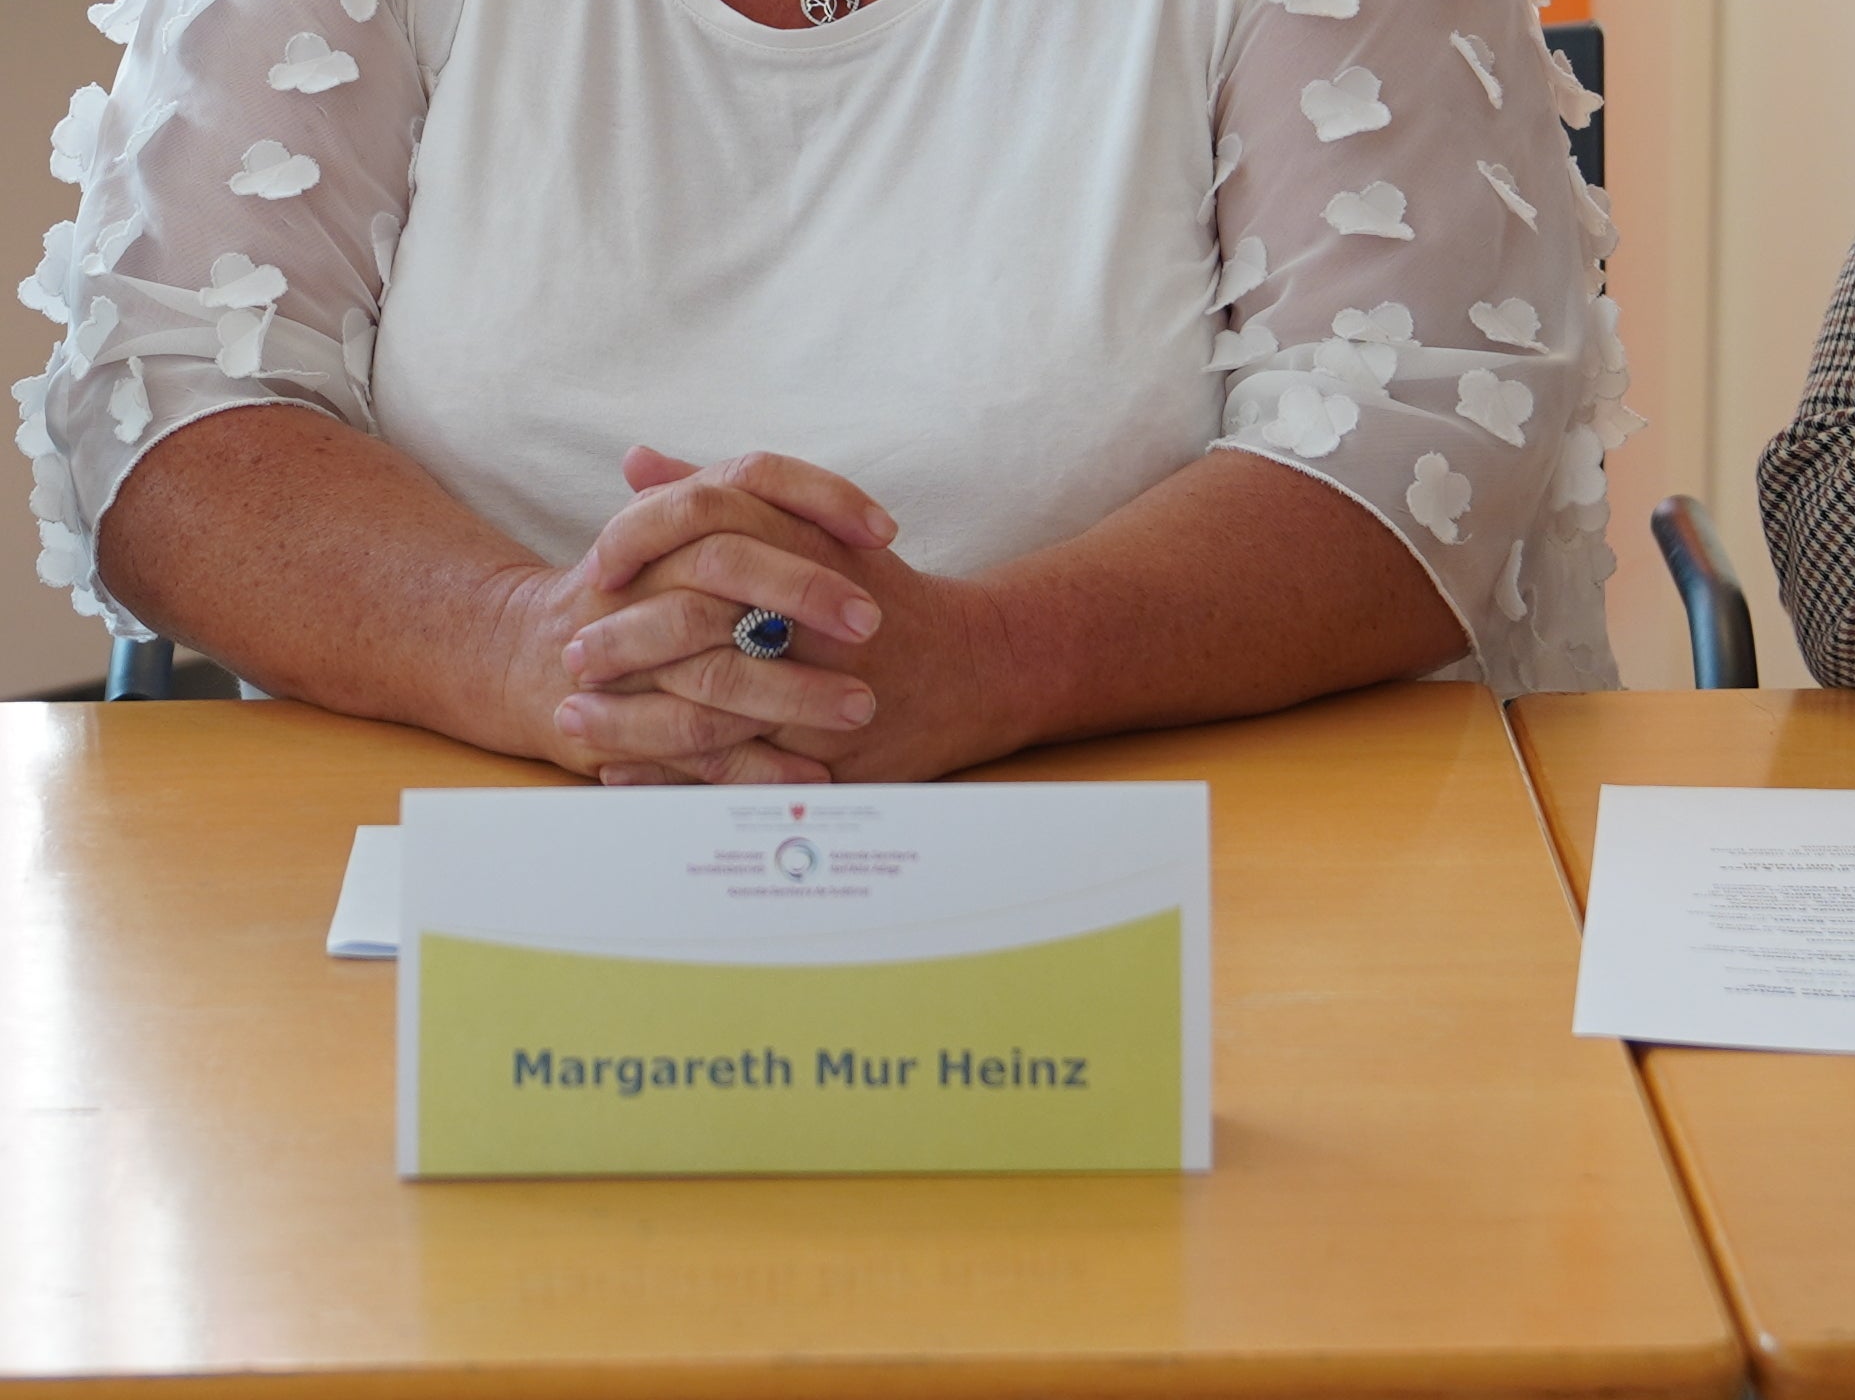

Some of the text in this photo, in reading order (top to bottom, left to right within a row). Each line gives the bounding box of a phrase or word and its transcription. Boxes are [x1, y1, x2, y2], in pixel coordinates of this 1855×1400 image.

[513, 1046, 1088, 1098] Margareth Mur Heinz
